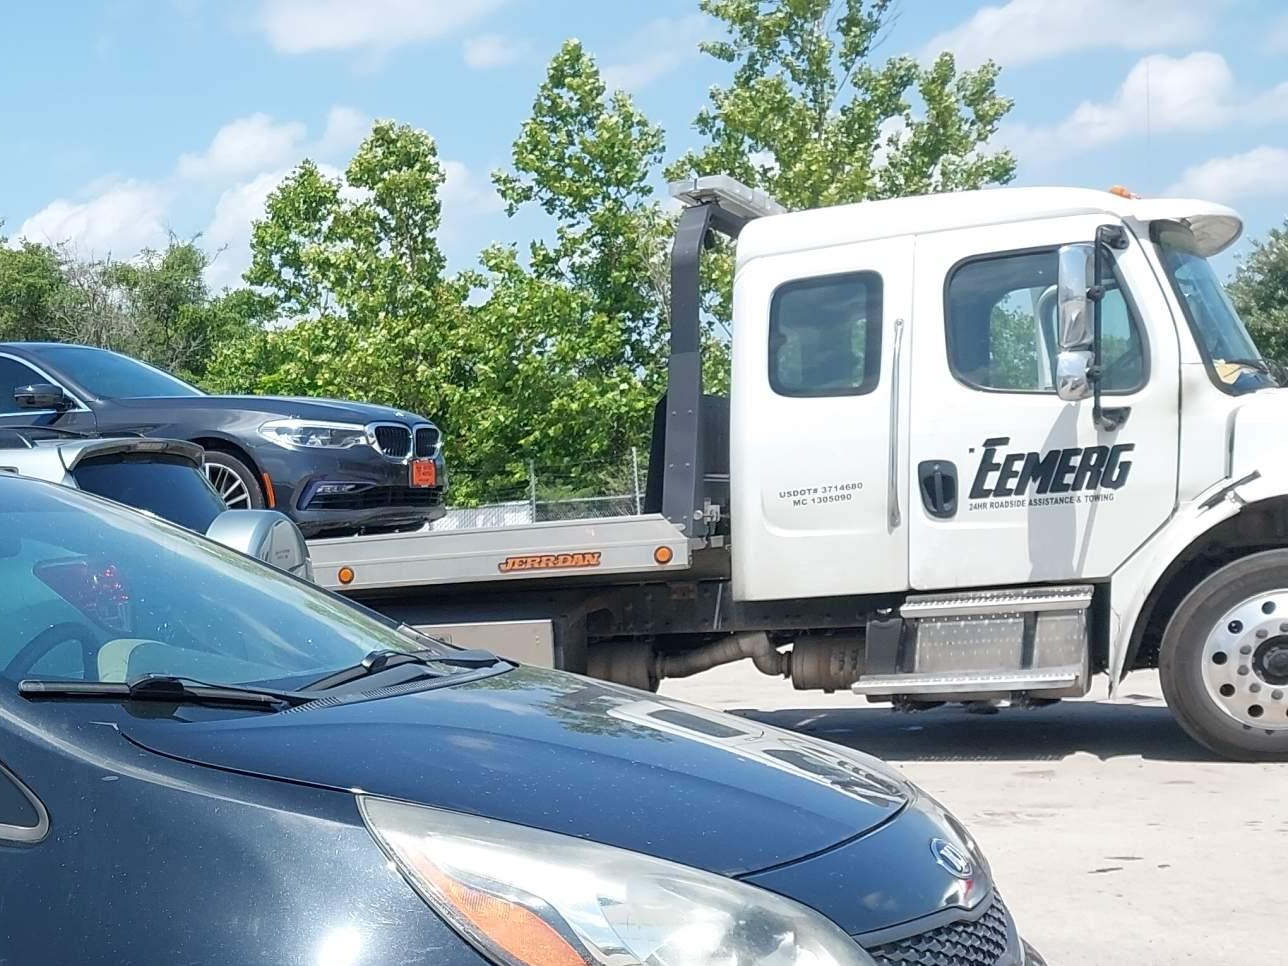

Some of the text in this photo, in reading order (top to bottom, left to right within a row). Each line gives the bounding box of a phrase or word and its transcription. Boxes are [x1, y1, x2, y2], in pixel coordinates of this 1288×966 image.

[968, 436, 1136, 499] EEMERG
[778, 487, 819, 499] USDOT#
[792, 498, 808, 507] MC
[968, 502, 988, 511] 24HR
[989, 500, 1026, 510] ROADSIDE
[1028, 495, 1074, 507] ASSISTANCE
[1084, 493, 1115, 504] TOWING
